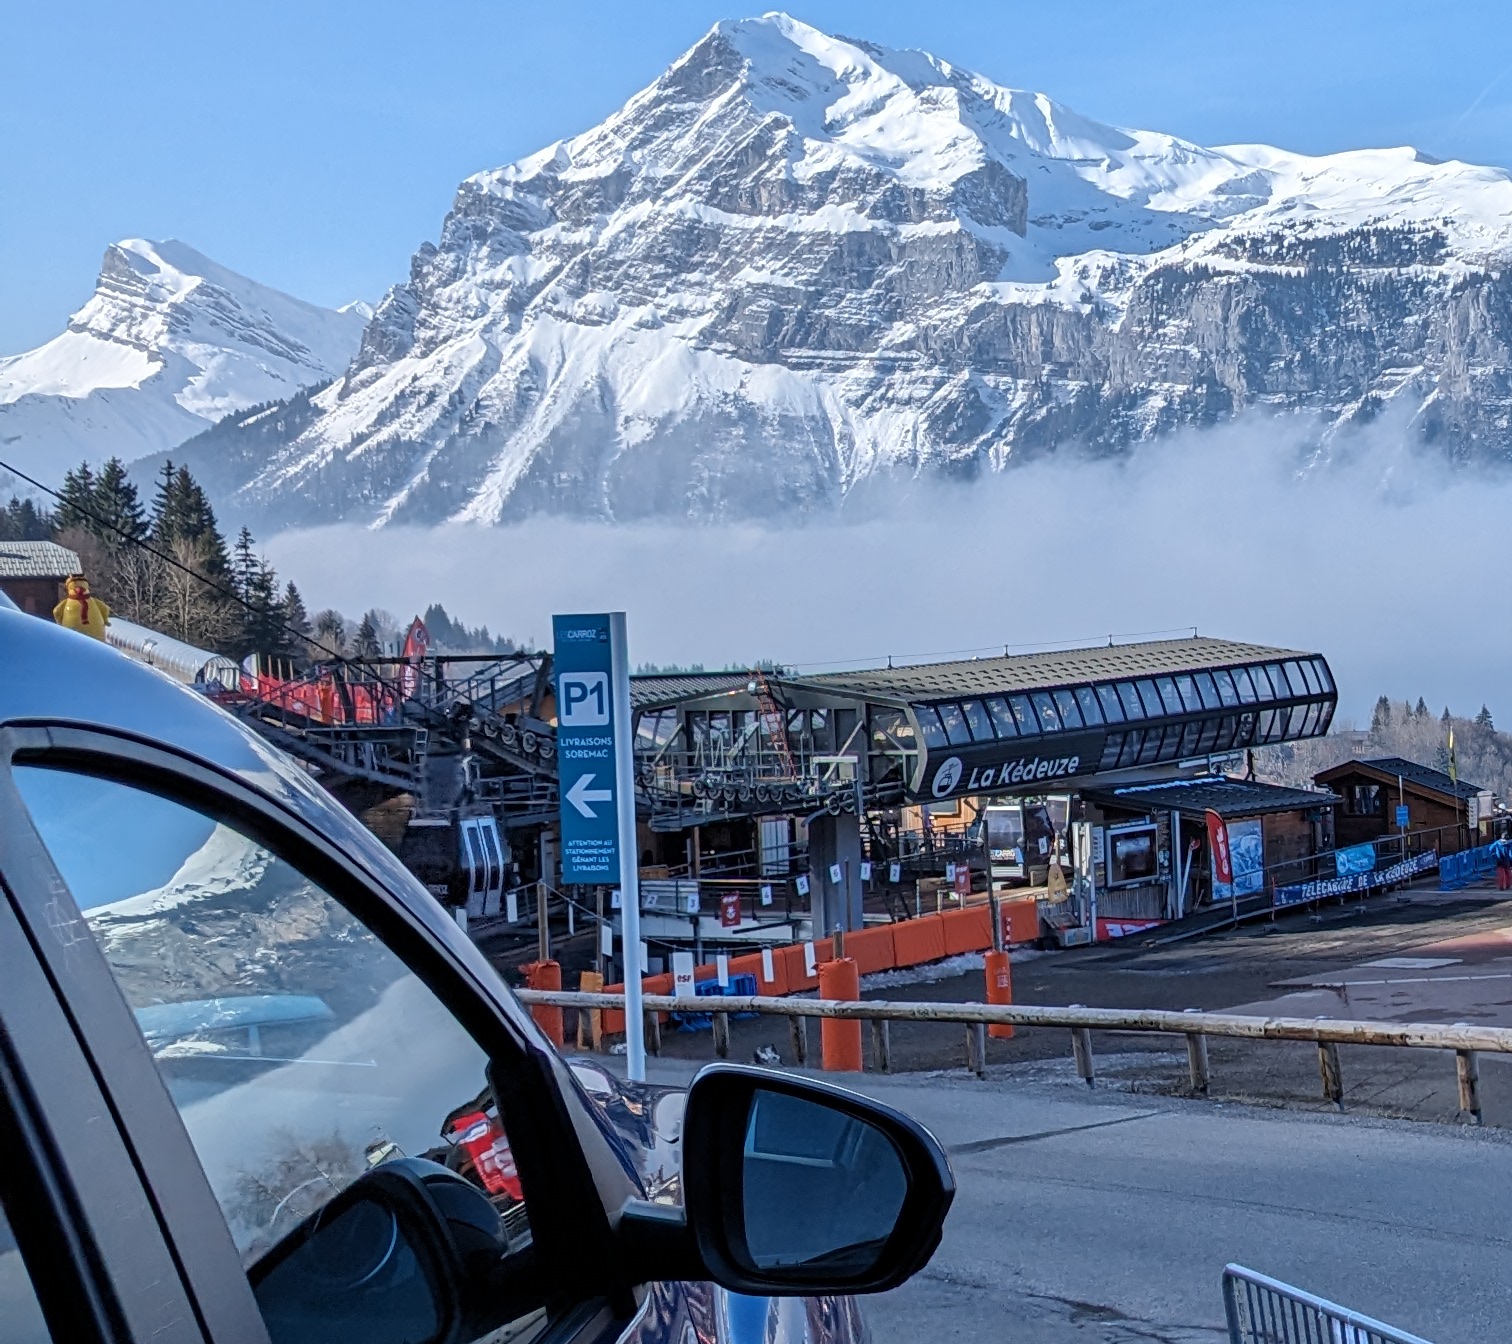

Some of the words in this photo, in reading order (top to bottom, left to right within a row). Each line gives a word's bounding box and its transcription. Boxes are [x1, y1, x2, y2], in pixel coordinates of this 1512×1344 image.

[563, 680, 604, 716] P1
[560, 737, 613, 747] LIVRAISONS
[565, 749, 609, 759] SOREMAC
[967, 767, 996, 790] La
[997, 756, 1080, 786] Kédeuze
